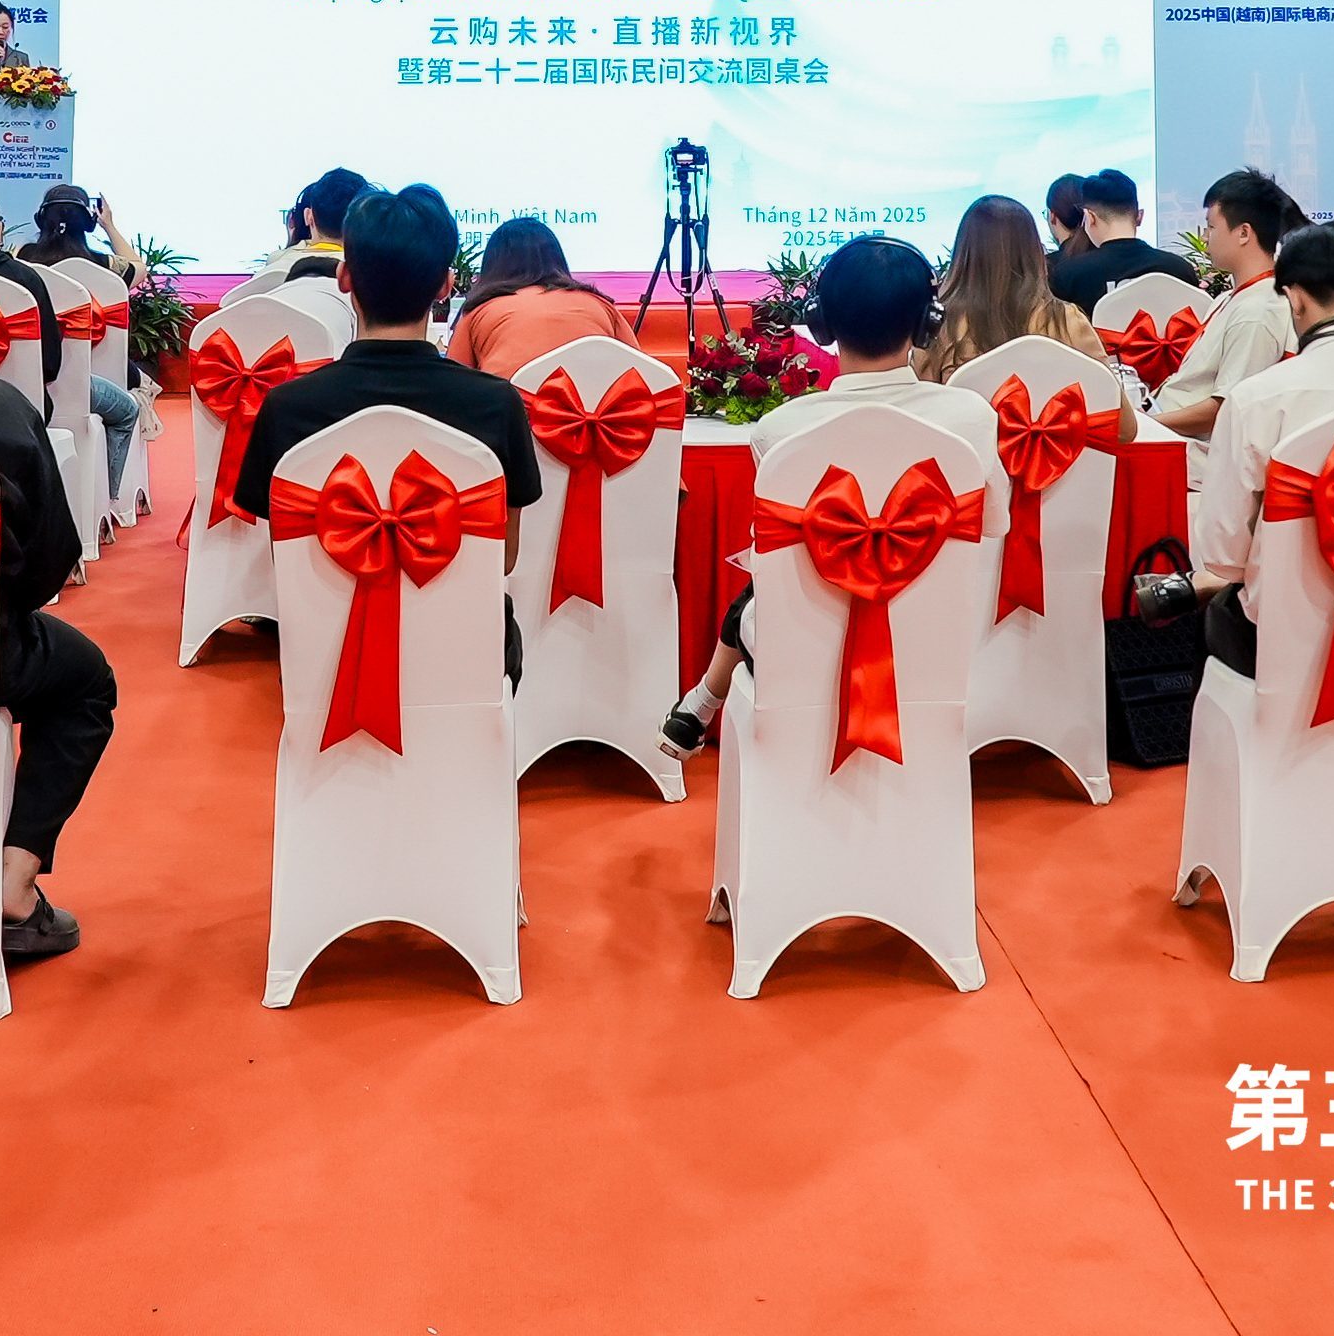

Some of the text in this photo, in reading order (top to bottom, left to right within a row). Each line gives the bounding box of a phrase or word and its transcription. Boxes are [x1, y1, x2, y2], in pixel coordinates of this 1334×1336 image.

[397, 57, 829, 85] 暨第二十二届国际民间交流圆桌会
[555, 209, 598, 224] Nam
[743, 205, 927, 227] Tháng 12 Năm 2025
[1311, 212, 1334, 220] 2025
